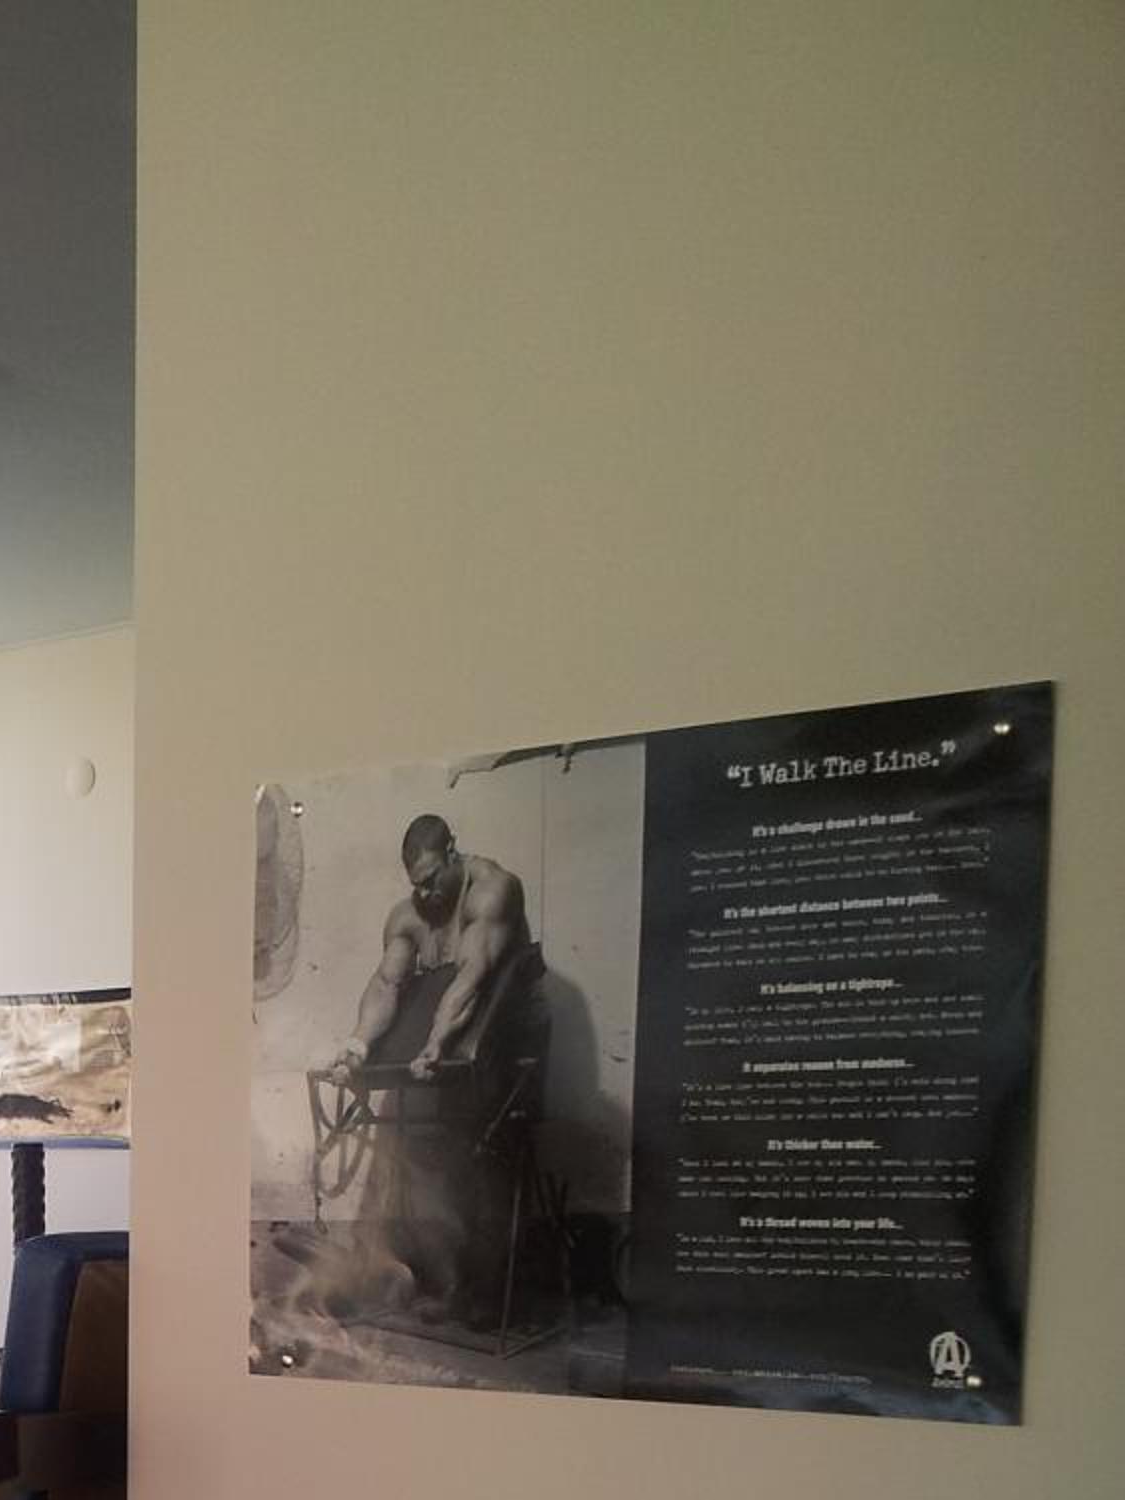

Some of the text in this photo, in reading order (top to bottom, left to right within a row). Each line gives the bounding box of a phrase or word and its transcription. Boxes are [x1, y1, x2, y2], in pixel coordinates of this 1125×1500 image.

[727, 739, 957, 789] “I Walk The Line.”
[752, 825, 767, 837] It's
[777, 821, 824, 835] challenge
[869, 812, 887, 825] the
[723, 907, 739, 919] It's
[740, 906, 756, 918] the
[798, 900, 841, 914] distance
[841, 897, 885, 911] between
[760, 983, 776, 995] It's
[777, 981, 825, 995] balancing
[835, 1057, 861, 1071] from
[767, 1138, 783, 1151] It's
[739, 1216, 755, 1228] It's
[852, 1218, 876, 1231] your
